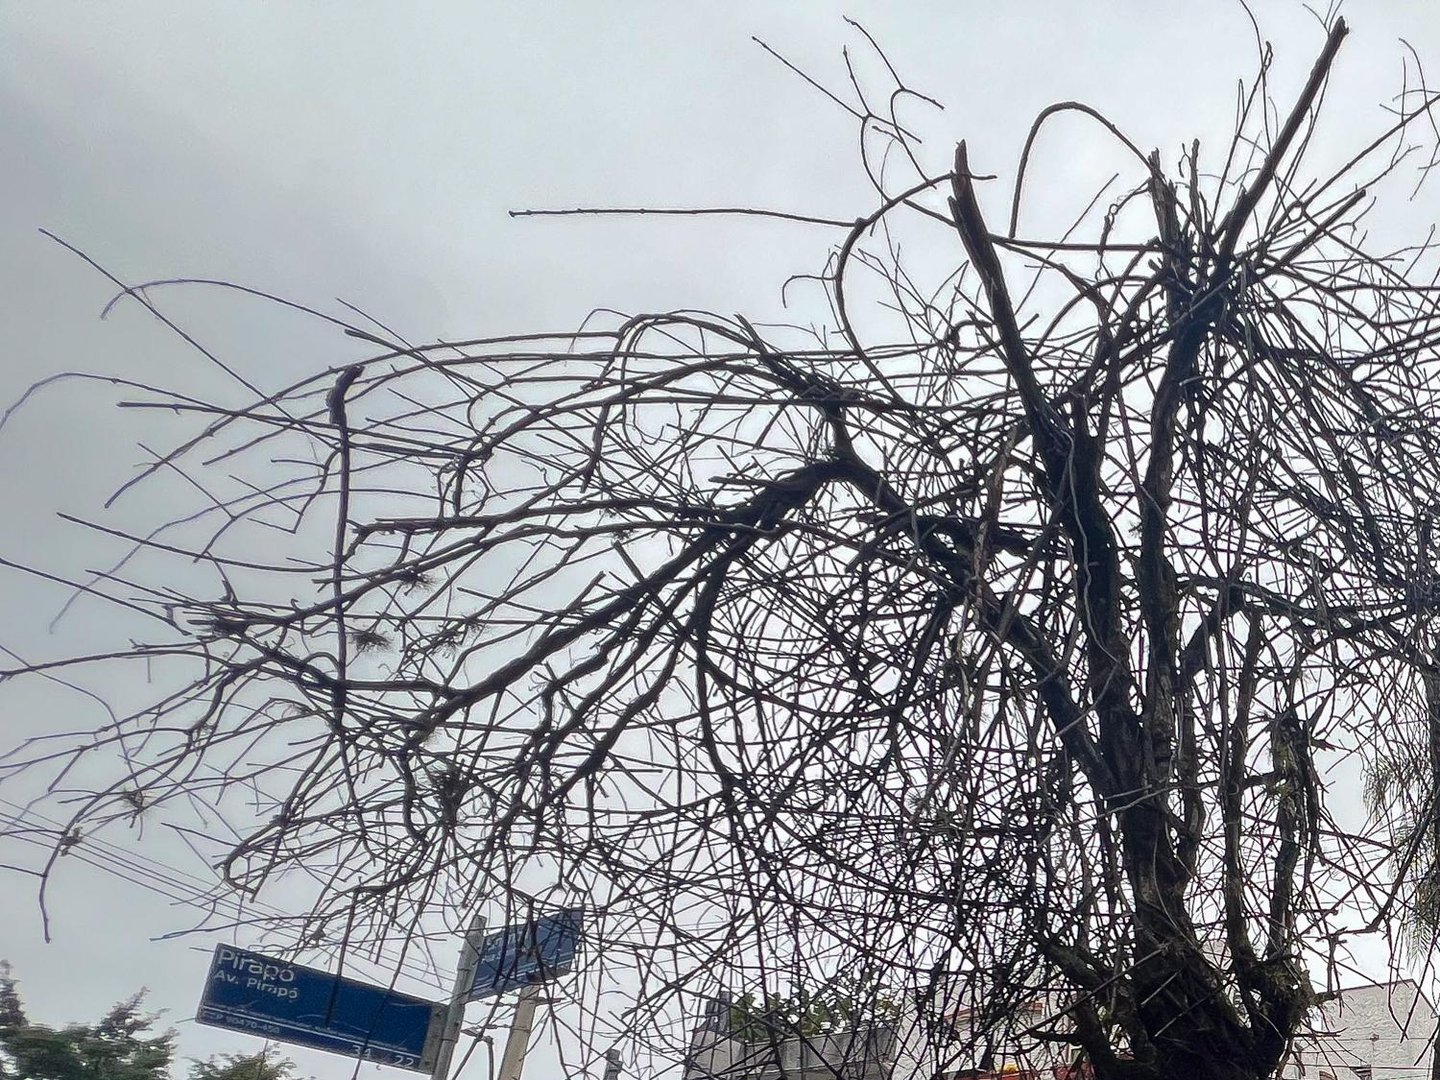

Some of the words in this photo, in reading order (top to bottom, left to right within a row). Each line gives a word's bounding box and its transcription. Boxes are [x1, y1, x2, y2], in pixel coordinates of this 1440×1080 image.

[218, 949, 295, 982] Pirapó
[213, 969, 239, 985] Av.
[391, 1054, 415, 1069] 22
